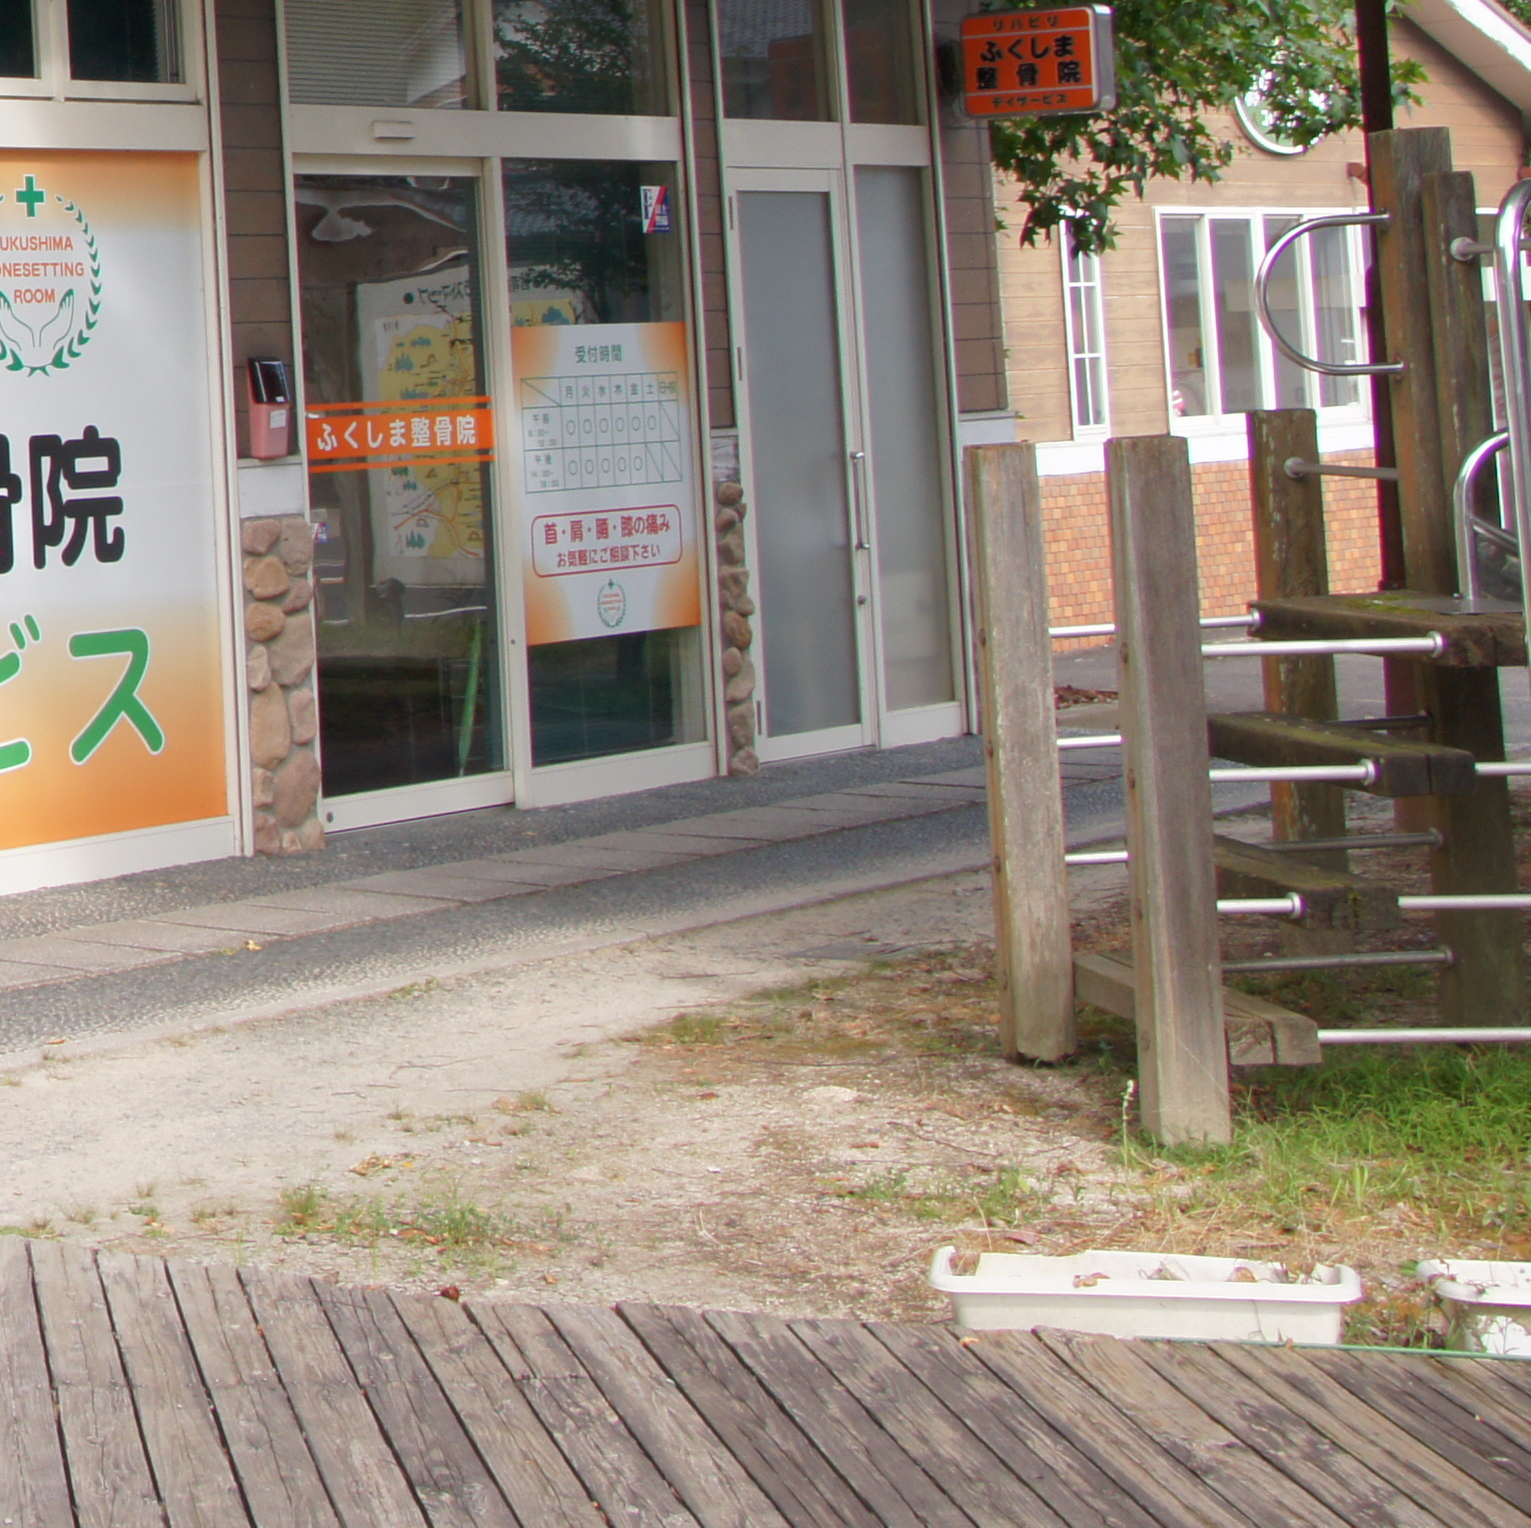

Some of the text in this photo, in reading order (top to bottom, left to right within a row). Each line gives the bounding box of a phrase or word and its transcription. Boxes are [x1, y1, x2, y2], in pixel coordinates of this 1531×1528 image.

[981, 36, 1073, 62] ふくしま
[992, 94, 1066, 107] デイサービス
[14, 288, 56, 304] ROOM
[574, 344, 623, 364] 受付時間
[565, 385, 574, 399] 月
[629, 383, 639, 396] 金
[645, 383, 655, 395] 土
[316, 414, 477, 452] ふくしま整骨院
[556, 543, 661, 569] お気軽にご相談下さい
